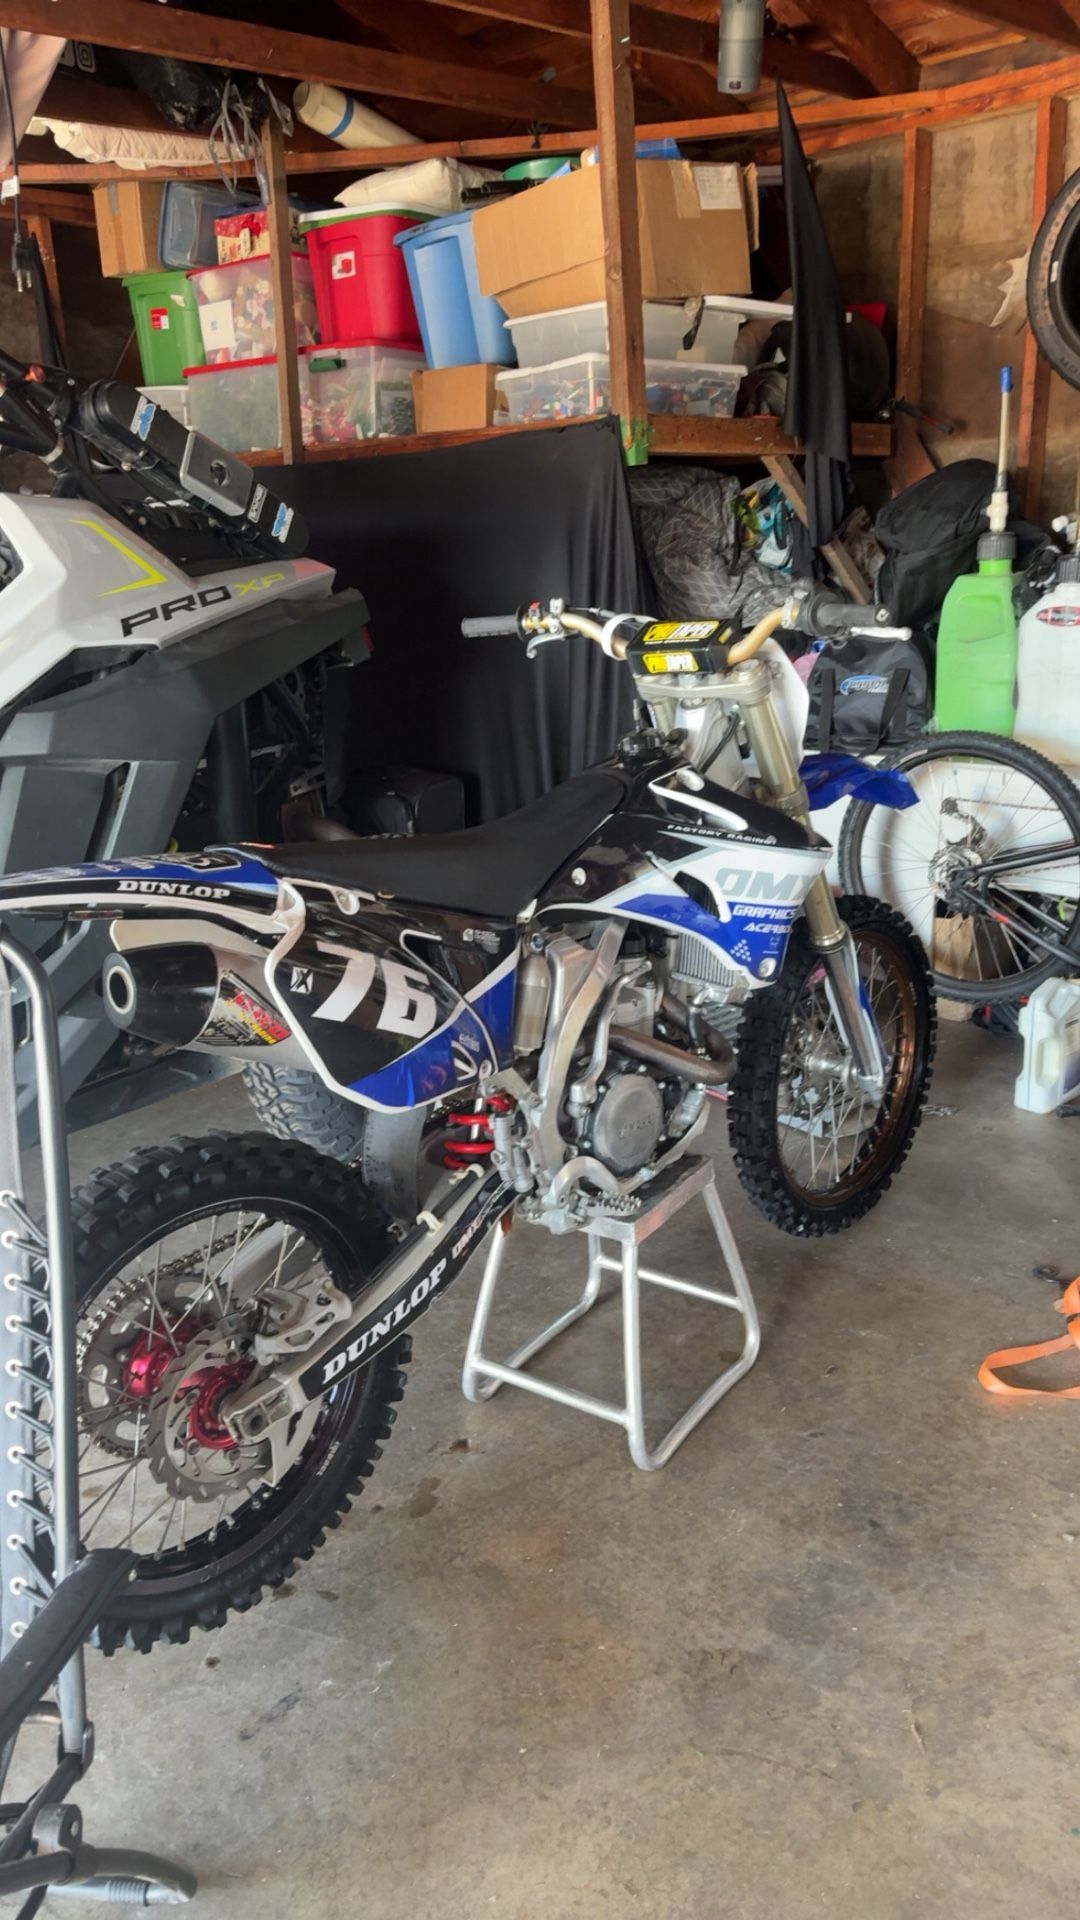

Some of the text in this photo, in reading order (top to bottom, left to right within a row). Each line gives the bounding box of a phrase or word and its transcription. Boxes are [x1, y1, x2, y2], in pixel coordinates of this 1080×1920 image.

[120, 573, 285, 637] PRO XP
[667, 824, 772, 845] FACTORY RACING
[117, 880, 231, 899] DUNLOP
[732, 904, 797, 920] GRAPHICS
[311, 940, 438, 1039] 76
[322, 1257, 447, 1385] DUNLOP
